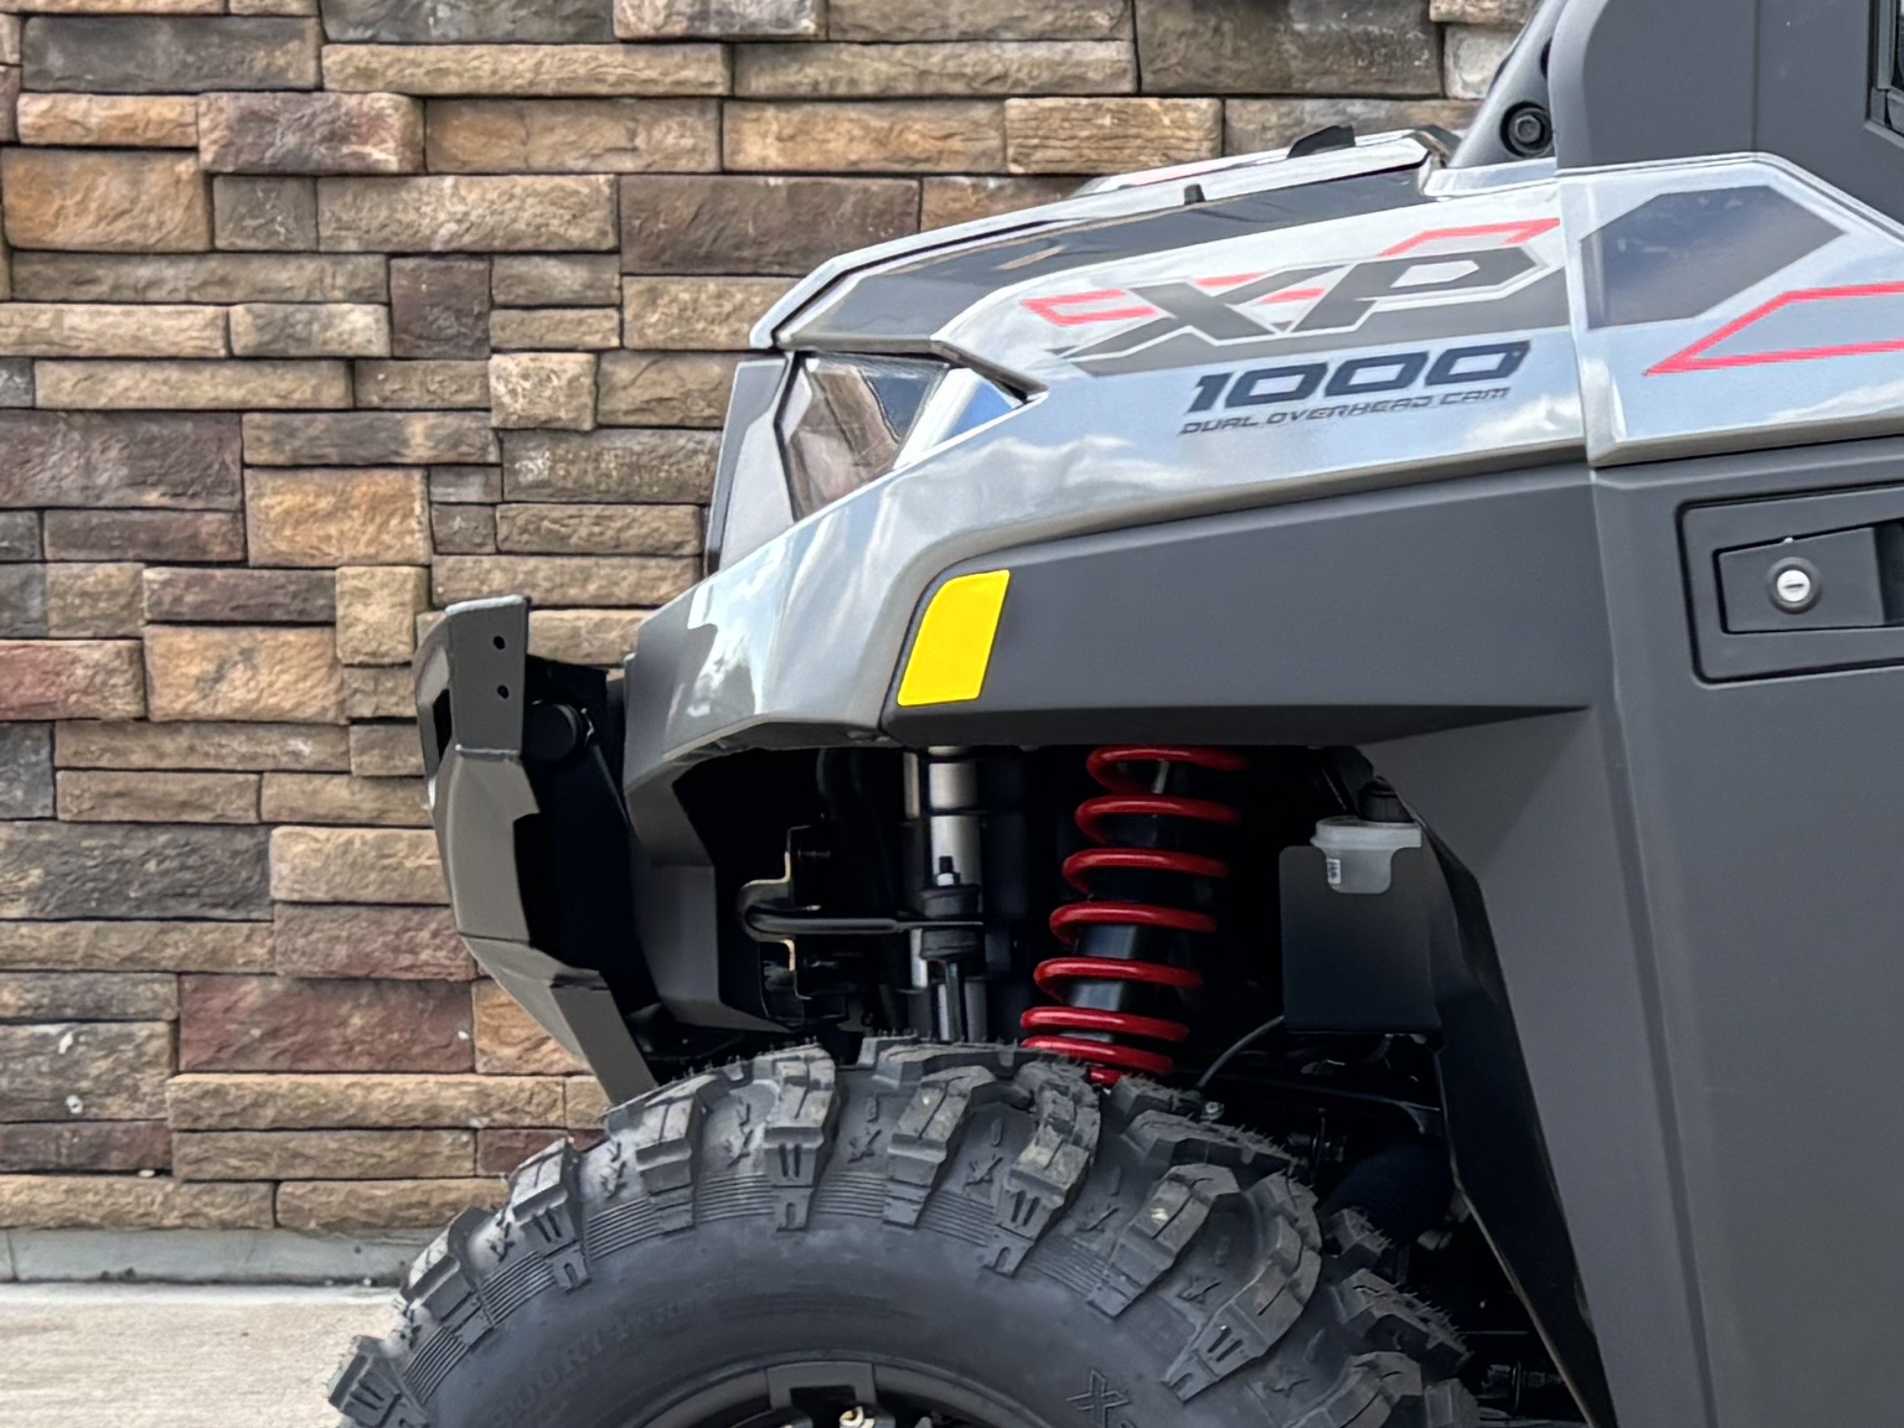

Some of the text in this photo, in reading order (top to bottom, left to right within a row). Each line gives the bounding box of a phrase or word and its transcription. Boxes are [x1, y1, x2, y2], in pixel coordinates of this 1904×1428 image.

[1052, 246, 1538, 359] XP
[1179, 387, 1512, 436] DUAL OVERHEAD CAM
[1188, 340, 1532, 414] 1000
